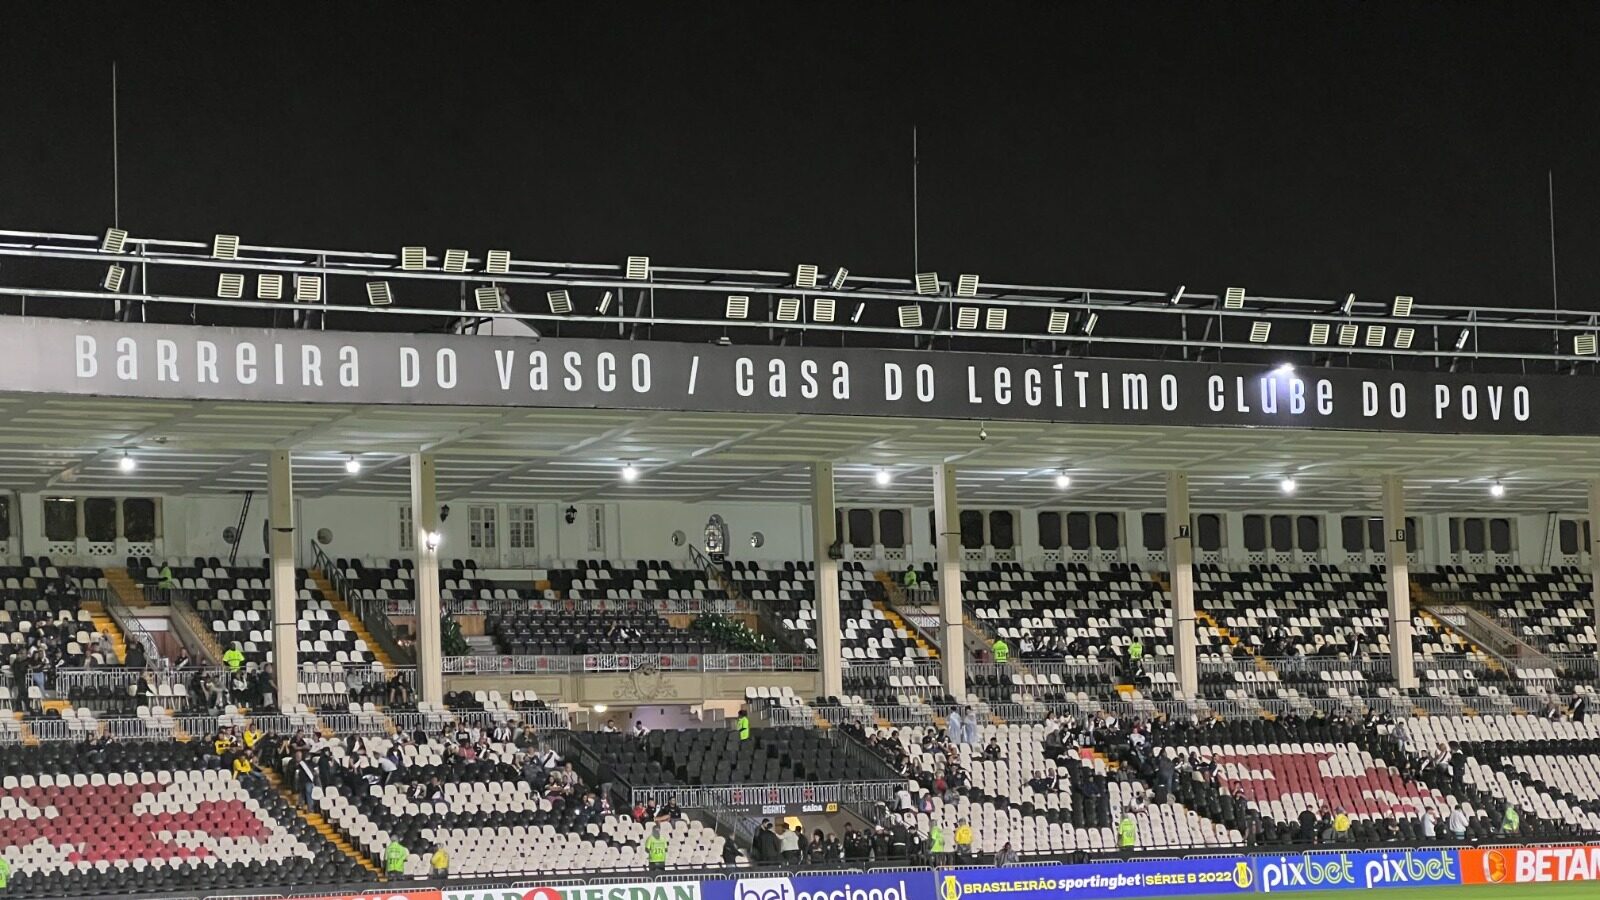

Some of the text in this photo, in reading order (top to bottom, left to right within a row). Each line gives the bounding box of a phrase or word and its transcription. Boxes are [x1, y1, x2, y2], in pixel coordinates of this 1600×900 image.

[399, 347, 457, 389] DO
[884, 362, 935, 403] DO
[1362, 380, 1407, 419] DO
[1434, 384, 1530, 422] POVO
[1181, 526, 1187, 537] 7
[1397, 530, 1404, 540] 8
[963, 871, 1233, 894] BRASILEIRÃO sportingbet SÉRIE B 2022
[1263, 850, 1456, 893] pixbet pixbet
